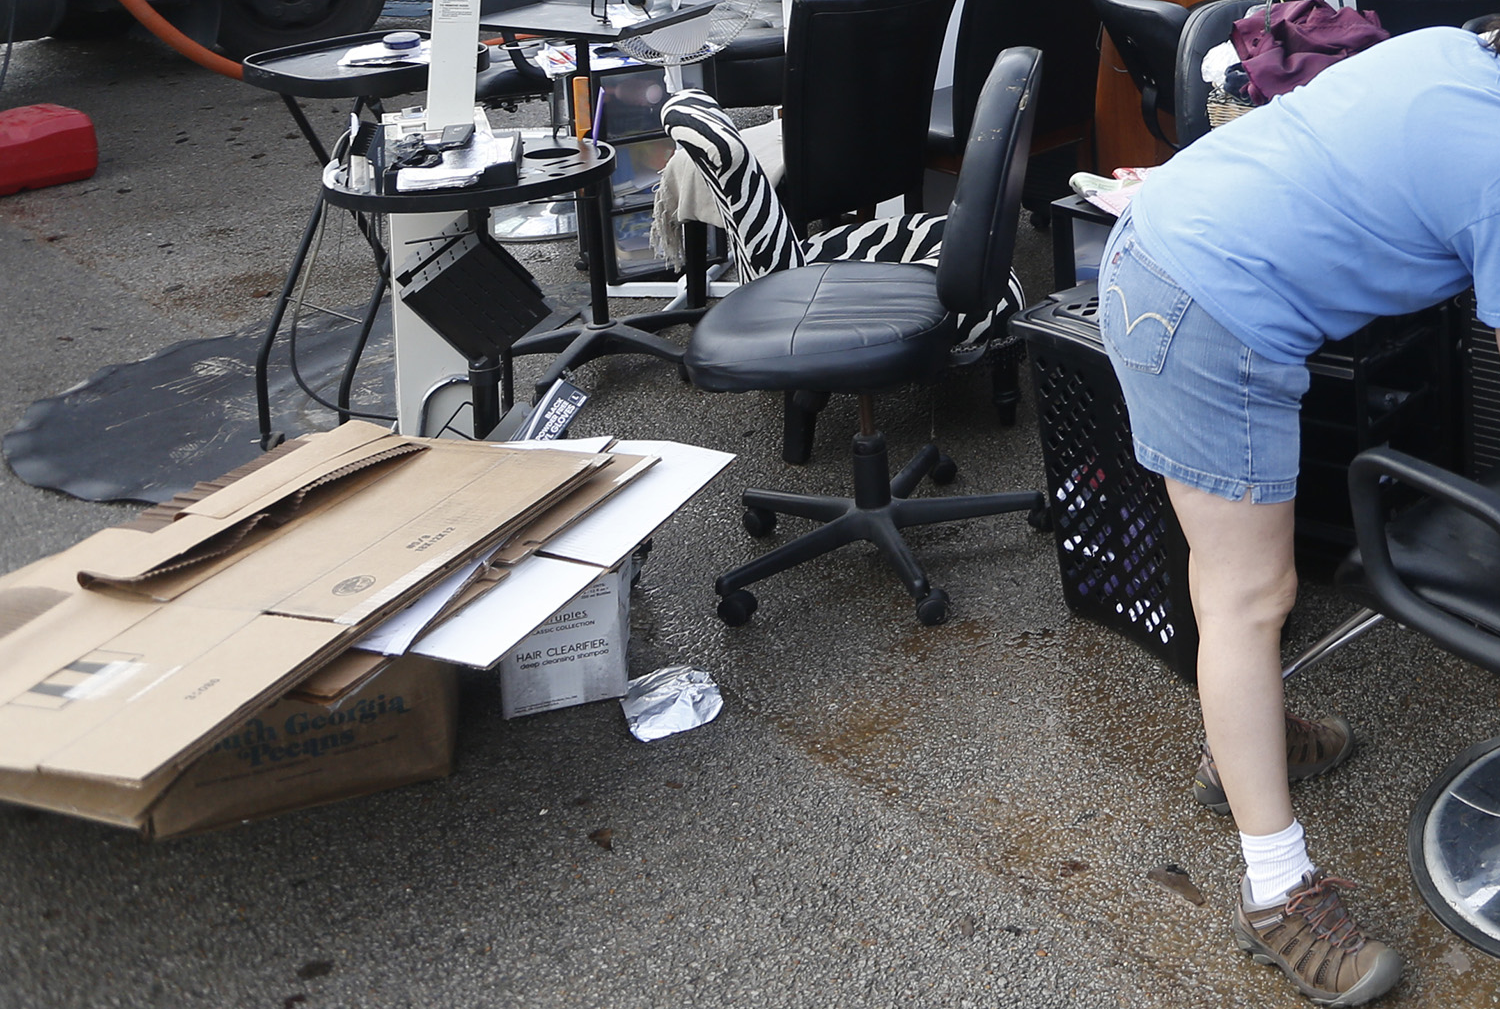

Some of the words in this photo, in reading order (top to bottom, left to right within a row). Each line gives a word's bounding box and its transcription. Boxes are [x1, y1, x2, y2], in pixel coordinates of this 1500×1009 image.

[544, 397, 563, 419] BLACK
[550, 403, 576, 433] GLOVES
[555, 400, 570, 415] FREE
[555, 620, 595, 632] COLLECTION
[516, 651, 542, 663] HAIR
[520, 662, 540, 671] deep
[542, 655, 575, 666] cleansing
[577, 649, 609, 660] shampoo
[285, 694, 411, 736] Georgia
[239, 728, 355, 767] Pecans
